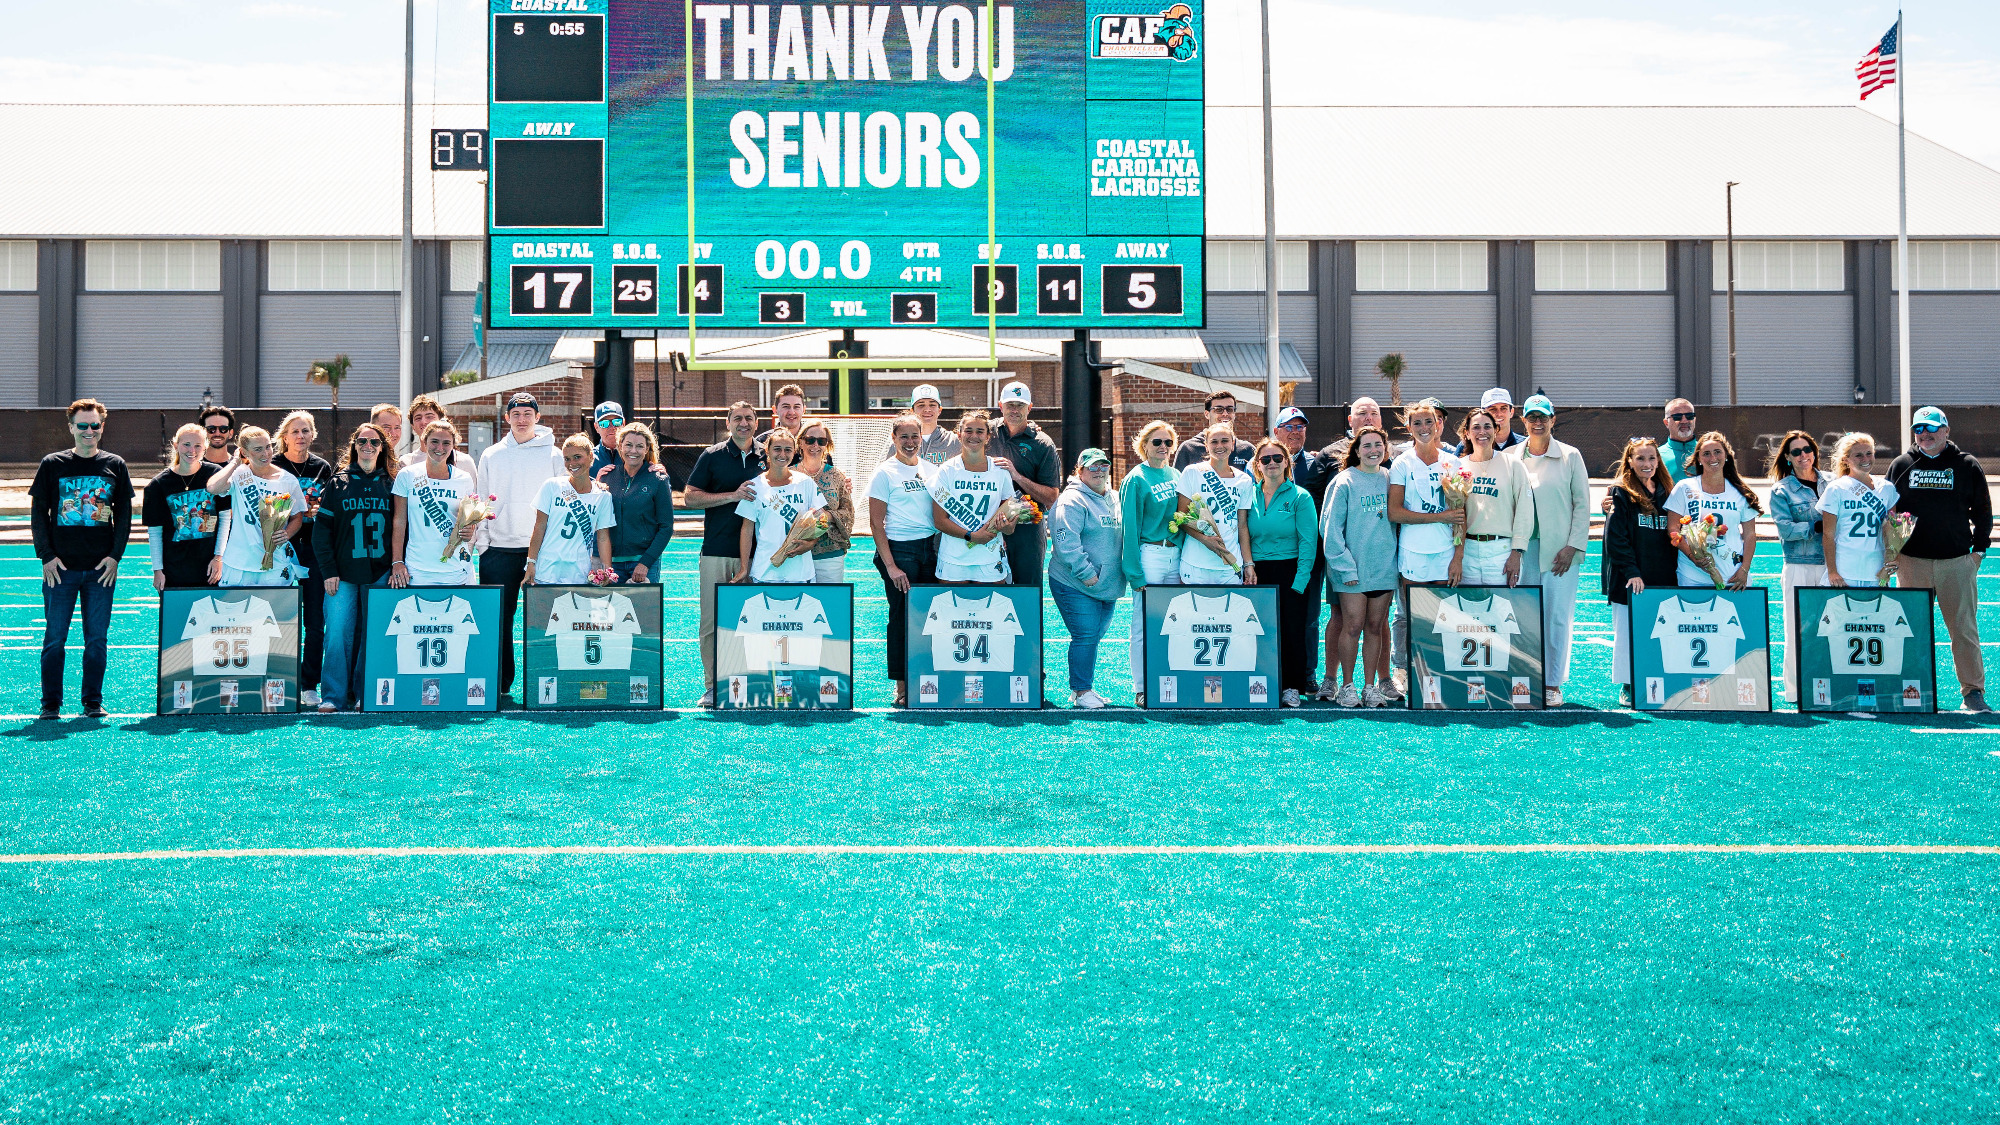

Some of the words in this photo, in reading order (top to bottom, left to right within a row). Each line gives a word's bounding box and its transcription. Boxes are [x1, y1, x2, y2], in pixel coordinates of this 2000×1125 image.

[511, 0, 588, 11] COASTAL
[513, 22, 524, 36] 5
[550, 22, 585, 36] 0:55
[1101, 17, 1165, 44] CAF
[696, 5, 891, 80] THANK
[900, 5, 1014, 81] YOU
[523, 122, 575, 136] AWAY
[434, 131, 483, 166] 89
[730, 111, 981, 188] SENIORS
[1096, 140, 1195, 157] COASTAL
[1091, 158, 1200, 177] CAROLINA
[1091, 178, 1200, 197] LACROSSE
[512, 243, 593, 258] COASTAL
[612, 244, 662, 260] S.O.G.
[754, 240, 871, 279] 00.0
[902, 242, 940, 259] QTR
[978, 243, 1003, 260] SV
[1036, 243, 1086, 260] S.O.G.
[1115, 243, 1170, 258] AWAY
[900, 267, 942, 282] 4TH
[523, 273, 583, 309] 17
[618, 280, 653, 301] 25
[694, 279, 710, 301] 4
[987, 279, 1005, 301] 9
[1045, 279, 1077, 301] 11
[1127, 273, 1157, 309] 5
[774, 300, 791, 319] 3
[830, 300, 867, 317] TOL
[906, 301, 923, 319] 3
[1909, 477, 1952, 487] CAROLINA
[1910, 469, 1946, 479] COASTAL
[954, 480, 998, 491] COASTAL
[1203, 471, 1232, 508] SENIOR
[418, 486, 447, 526] SENIOR
[1361, 493, 1386, 506] COAST
[1701, 500, 1738, 511] ASTAL
[944, 497, 981, 531] SENIOR
[561, 512, 578, 539] 5
[1848, 511, 1880, 538] 29
[351, 513, 386, 559] 13
[211, 626, 252, 634] CHANTS
[413, 625, 454, 634] CHANTS
[572, 622, 613, 631] CHANTS
[762, 622, 803, 631] CHANTS
[951, 620, 993, 630] CHANTS
[1191, 624, 1232, 633] CHANTS
[1456, 624, 1496, 633] CHANTS
[1678, 624, 1718, 633] CHANTS
[1844, 623, 1885, 633] CHANTS
[213, 639, 249, 669] 35
[417, 638, 447, 668] 13
[584, 634, 602, 666] 5
[776, 635, 789, 665] 1
[953, 633, 990, 663] 34
[1193, 637, 1230, 667] 27
[1461, 637, 1492, 668] 21
[1690, 637, 1710, 668] 2
[1848, 636, 1884, 667] 29
